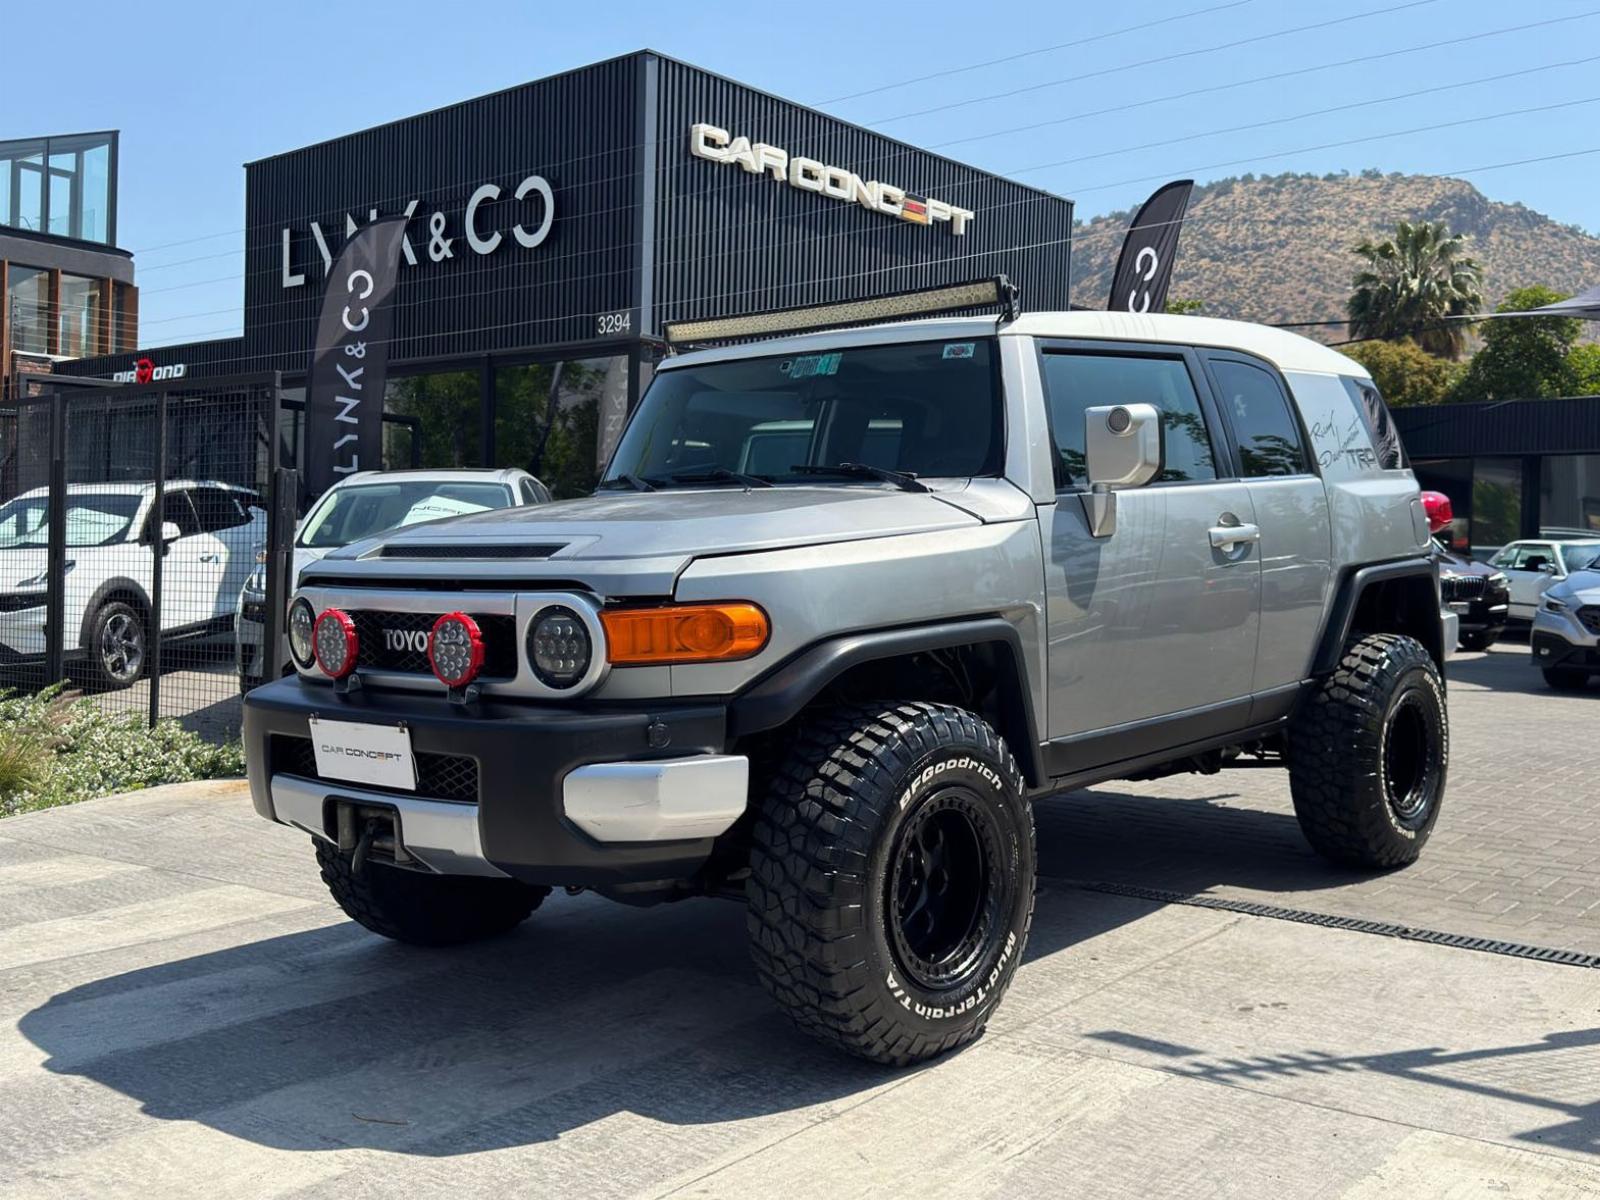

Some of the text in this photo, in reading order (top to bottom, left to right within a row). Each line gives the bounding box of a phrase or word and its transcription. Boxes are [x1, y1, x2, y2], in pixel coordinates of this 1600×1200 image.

[691, 122, 975, 236] CAR CONCEPT
[598, 312, 632, 335] 3294
[382, 628, 433, 653] TOYO
[321, 744, 402, 764] CAR CONCEPT
[899, 756, 1003, 811] BFGoodrich
[886, 971, 912, 1011] T/A
